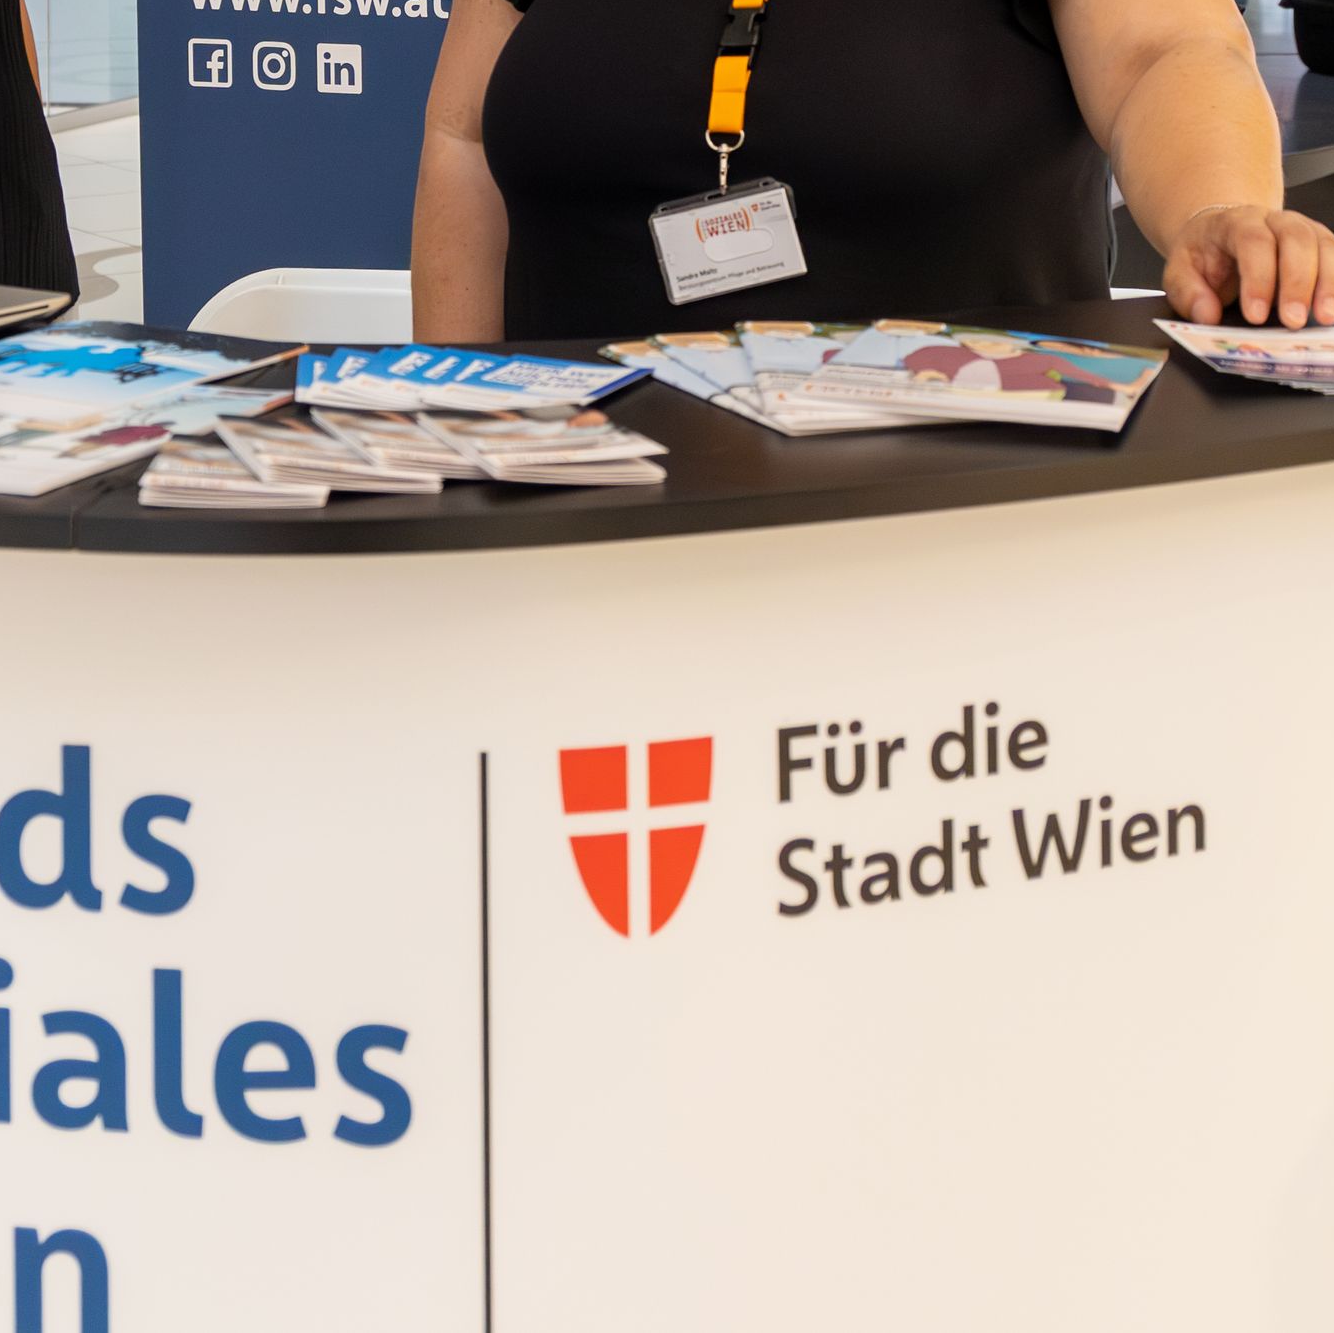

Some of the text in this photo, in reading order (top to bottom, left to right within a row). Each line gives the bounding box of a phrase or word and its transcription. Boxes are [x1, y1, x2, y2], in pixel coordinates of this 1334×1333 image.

[705, 212, 743, 225] SOZIALES
[707, 220, 746, 237] WIEN
[777, 702, 1048, 803] Für die
[777, 794, 1207, 918] Stadt Wien
